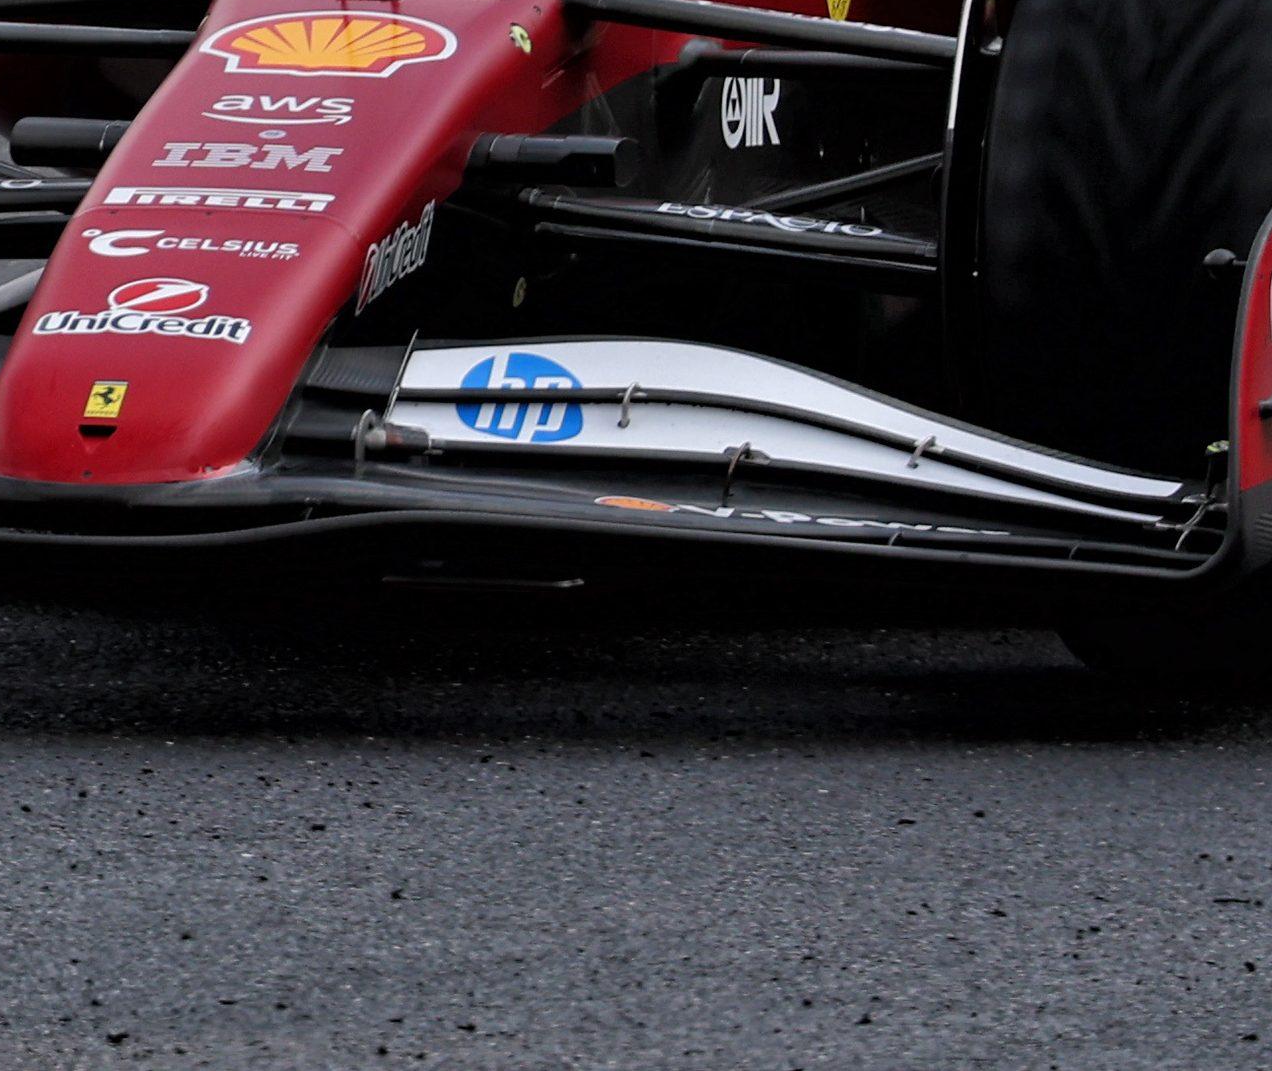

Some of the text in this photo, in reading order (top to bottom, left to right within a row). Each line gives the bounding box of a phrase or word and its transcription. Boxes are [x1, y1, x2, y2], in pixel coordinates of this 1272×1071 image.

[212, 94, 356, 115] aws
[152, 142, 345, 173] IBM
[103, 186, 336, 213] PIRELLI
[155, 236, 300, 256] CELSIUS
[32, 310, 253, 345] UniCredit
[478, 352, 582, 442] hp
